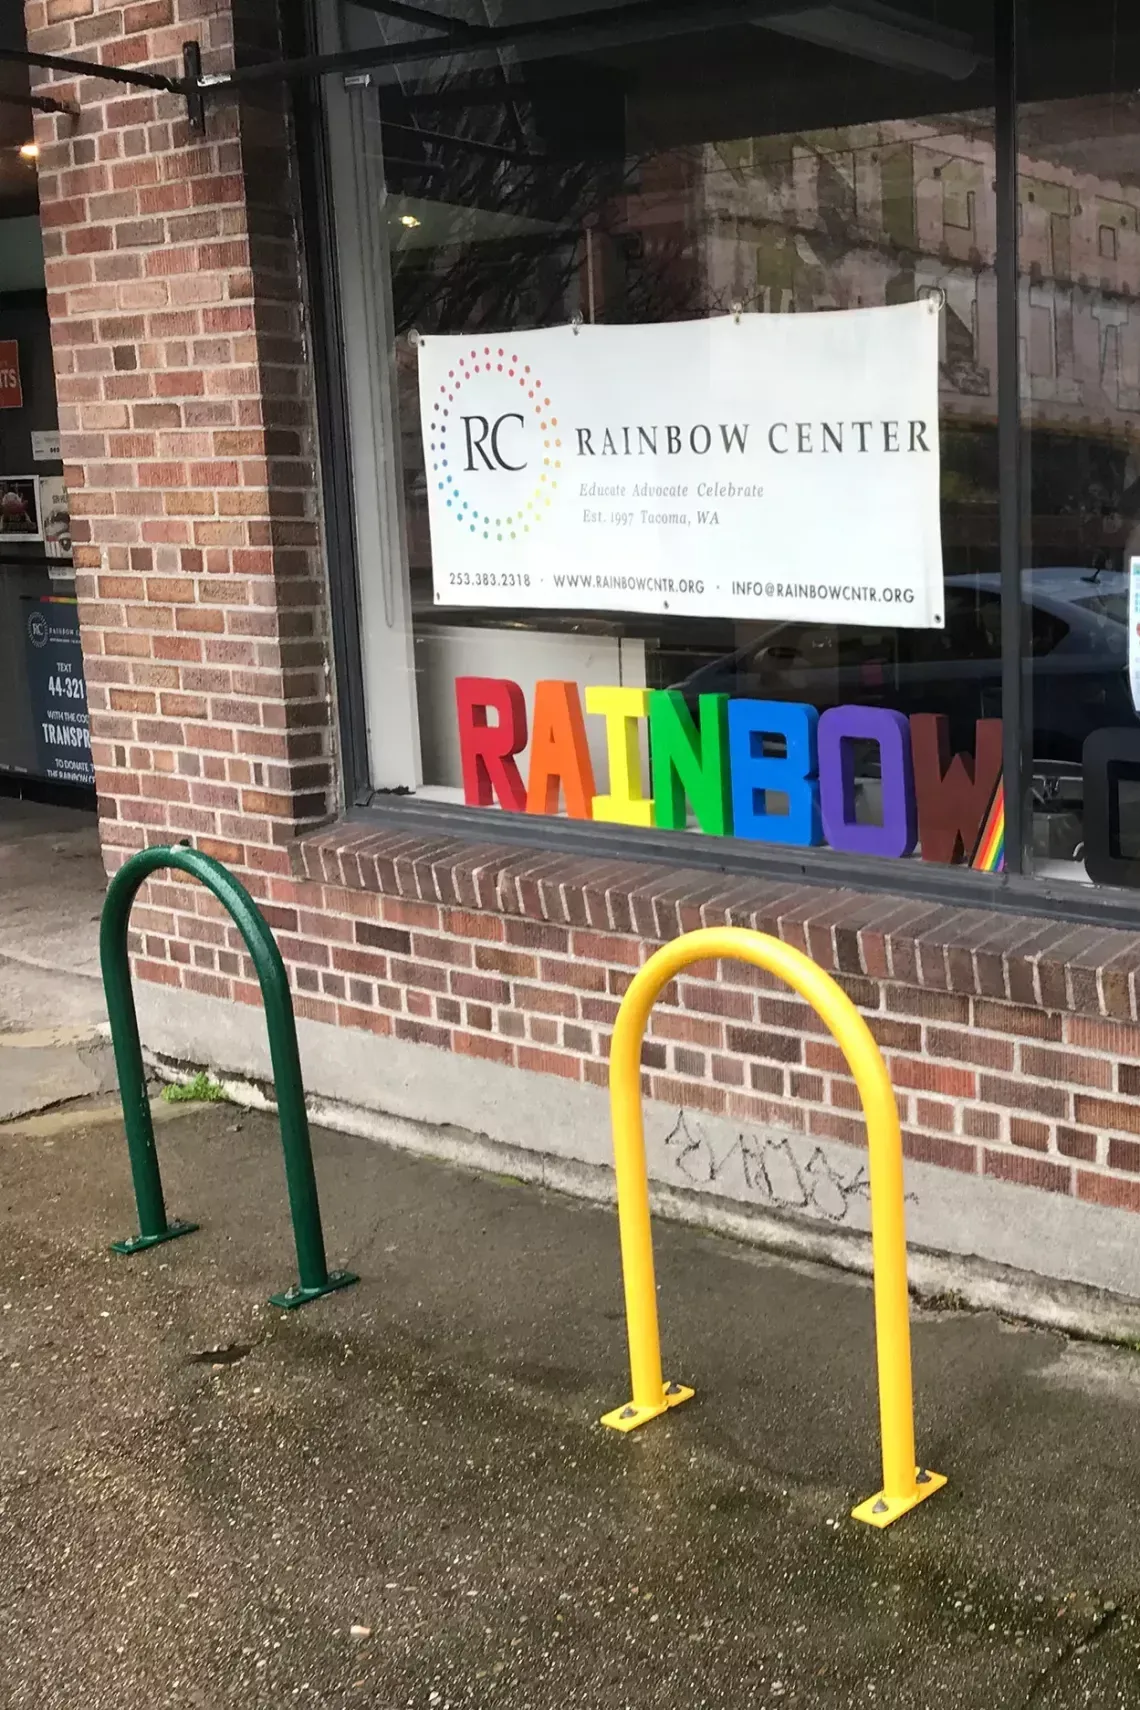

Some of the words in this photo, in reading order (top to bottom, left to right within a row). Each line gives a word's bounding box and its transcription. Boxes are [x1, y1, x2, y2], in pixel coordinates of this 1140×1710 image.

[460, 413, 529, 472] RC
[575, 423, 750, 457] RAINBOW
[768, 420, 931, 454] CENTER
[579, 481, 627, 498] Educate
[632, 481, 689, 498] Advocate
[696, 481, 764, 498] Celebrate
[582, 509, 607, 524] Est.
[610, 511, 634, 527] 1997
[640, 510, 691, 527] Tacoma,
[696, 510, 720, 525] WA
[449, 572, 531, 588] 253.383.2318
[552, 574, 705, 594] WWW.RAINBOWCNTR.ORG
[731, 581, 915, 604] INFO@RAINBOWCNTR.ORG
[56, 662, 72, 673] TEXT
[47, 709, 64, 720] WITH
[64, 711, 76, 722] THE
[55, 758, 64, 768] TO
[456, 676, 1004, 873] RAINBOW
